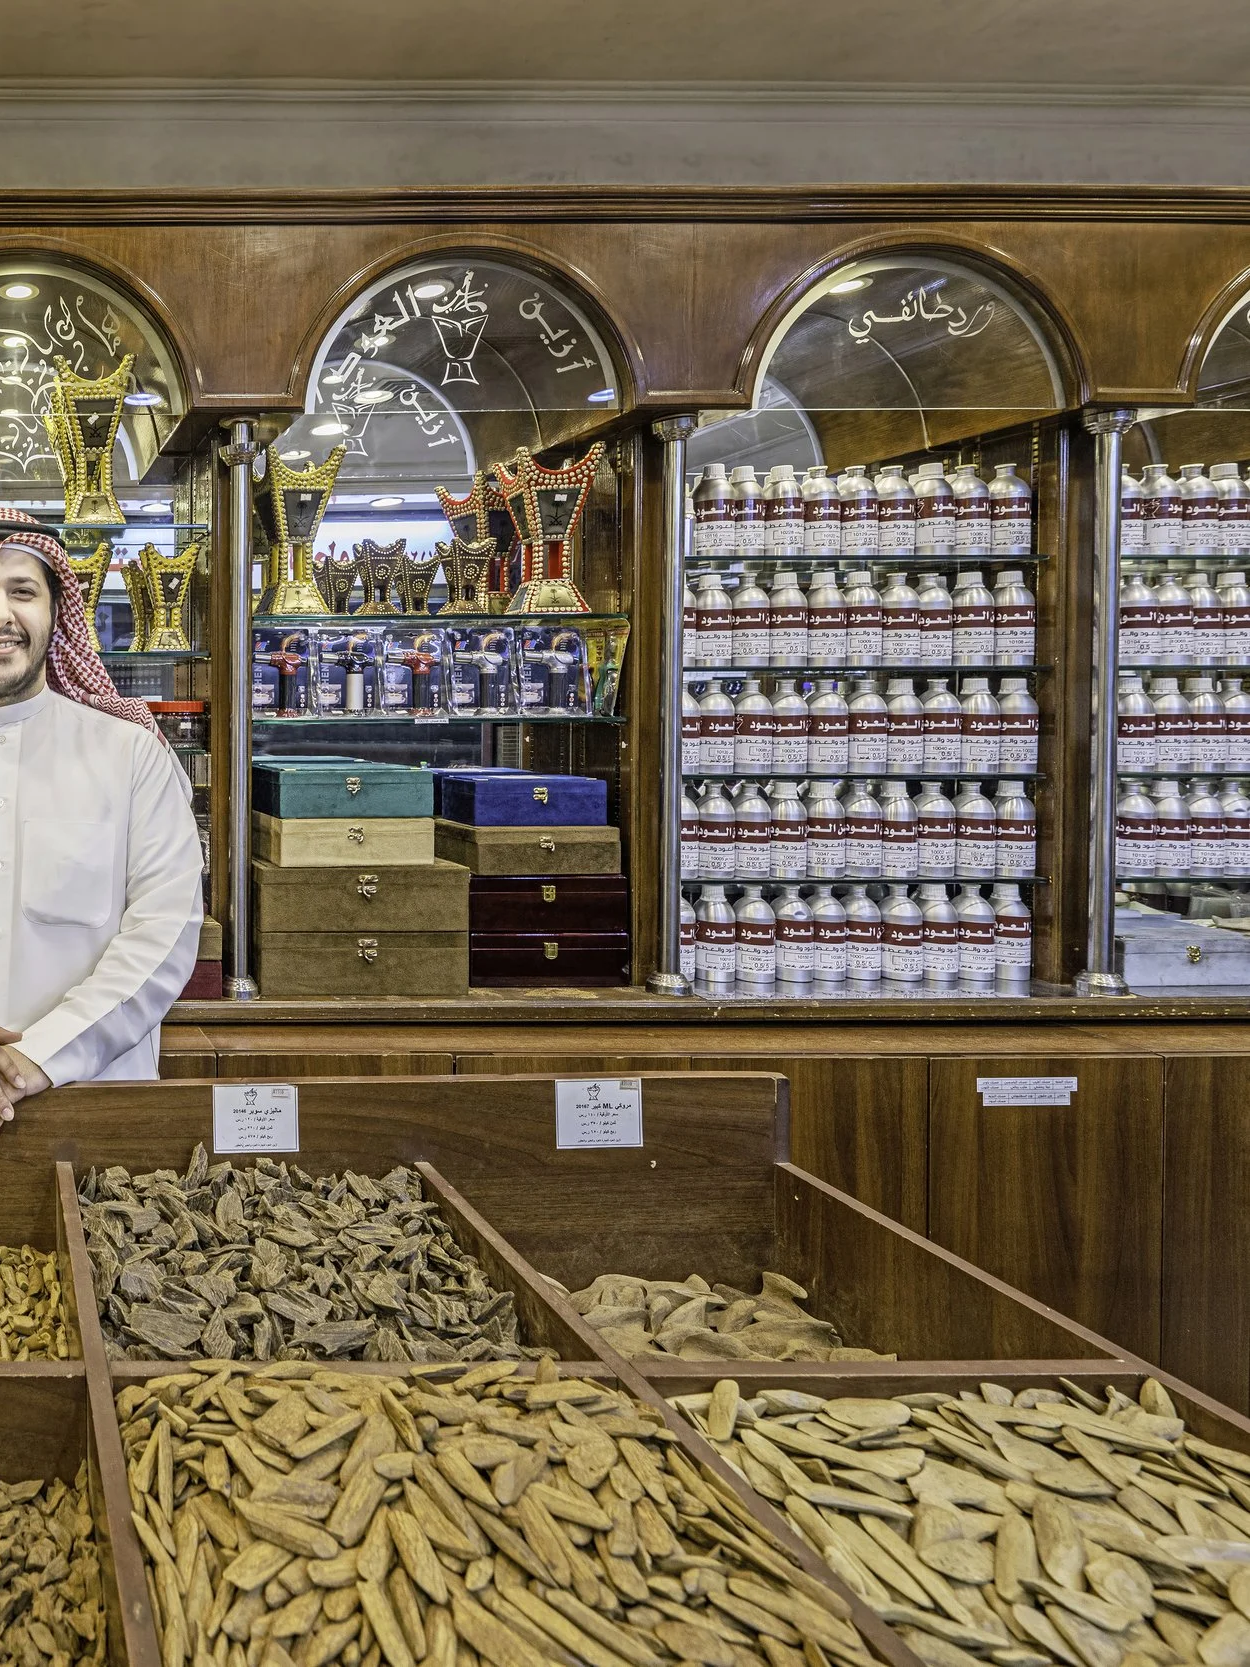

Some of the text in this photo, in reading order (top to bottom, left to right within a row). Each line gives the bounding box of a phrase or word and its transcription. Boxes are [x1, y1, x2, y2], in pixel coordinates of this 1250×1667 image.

[328, 283, 422, 384] العود
[848, 286, 996, 344] ورد طائفي
